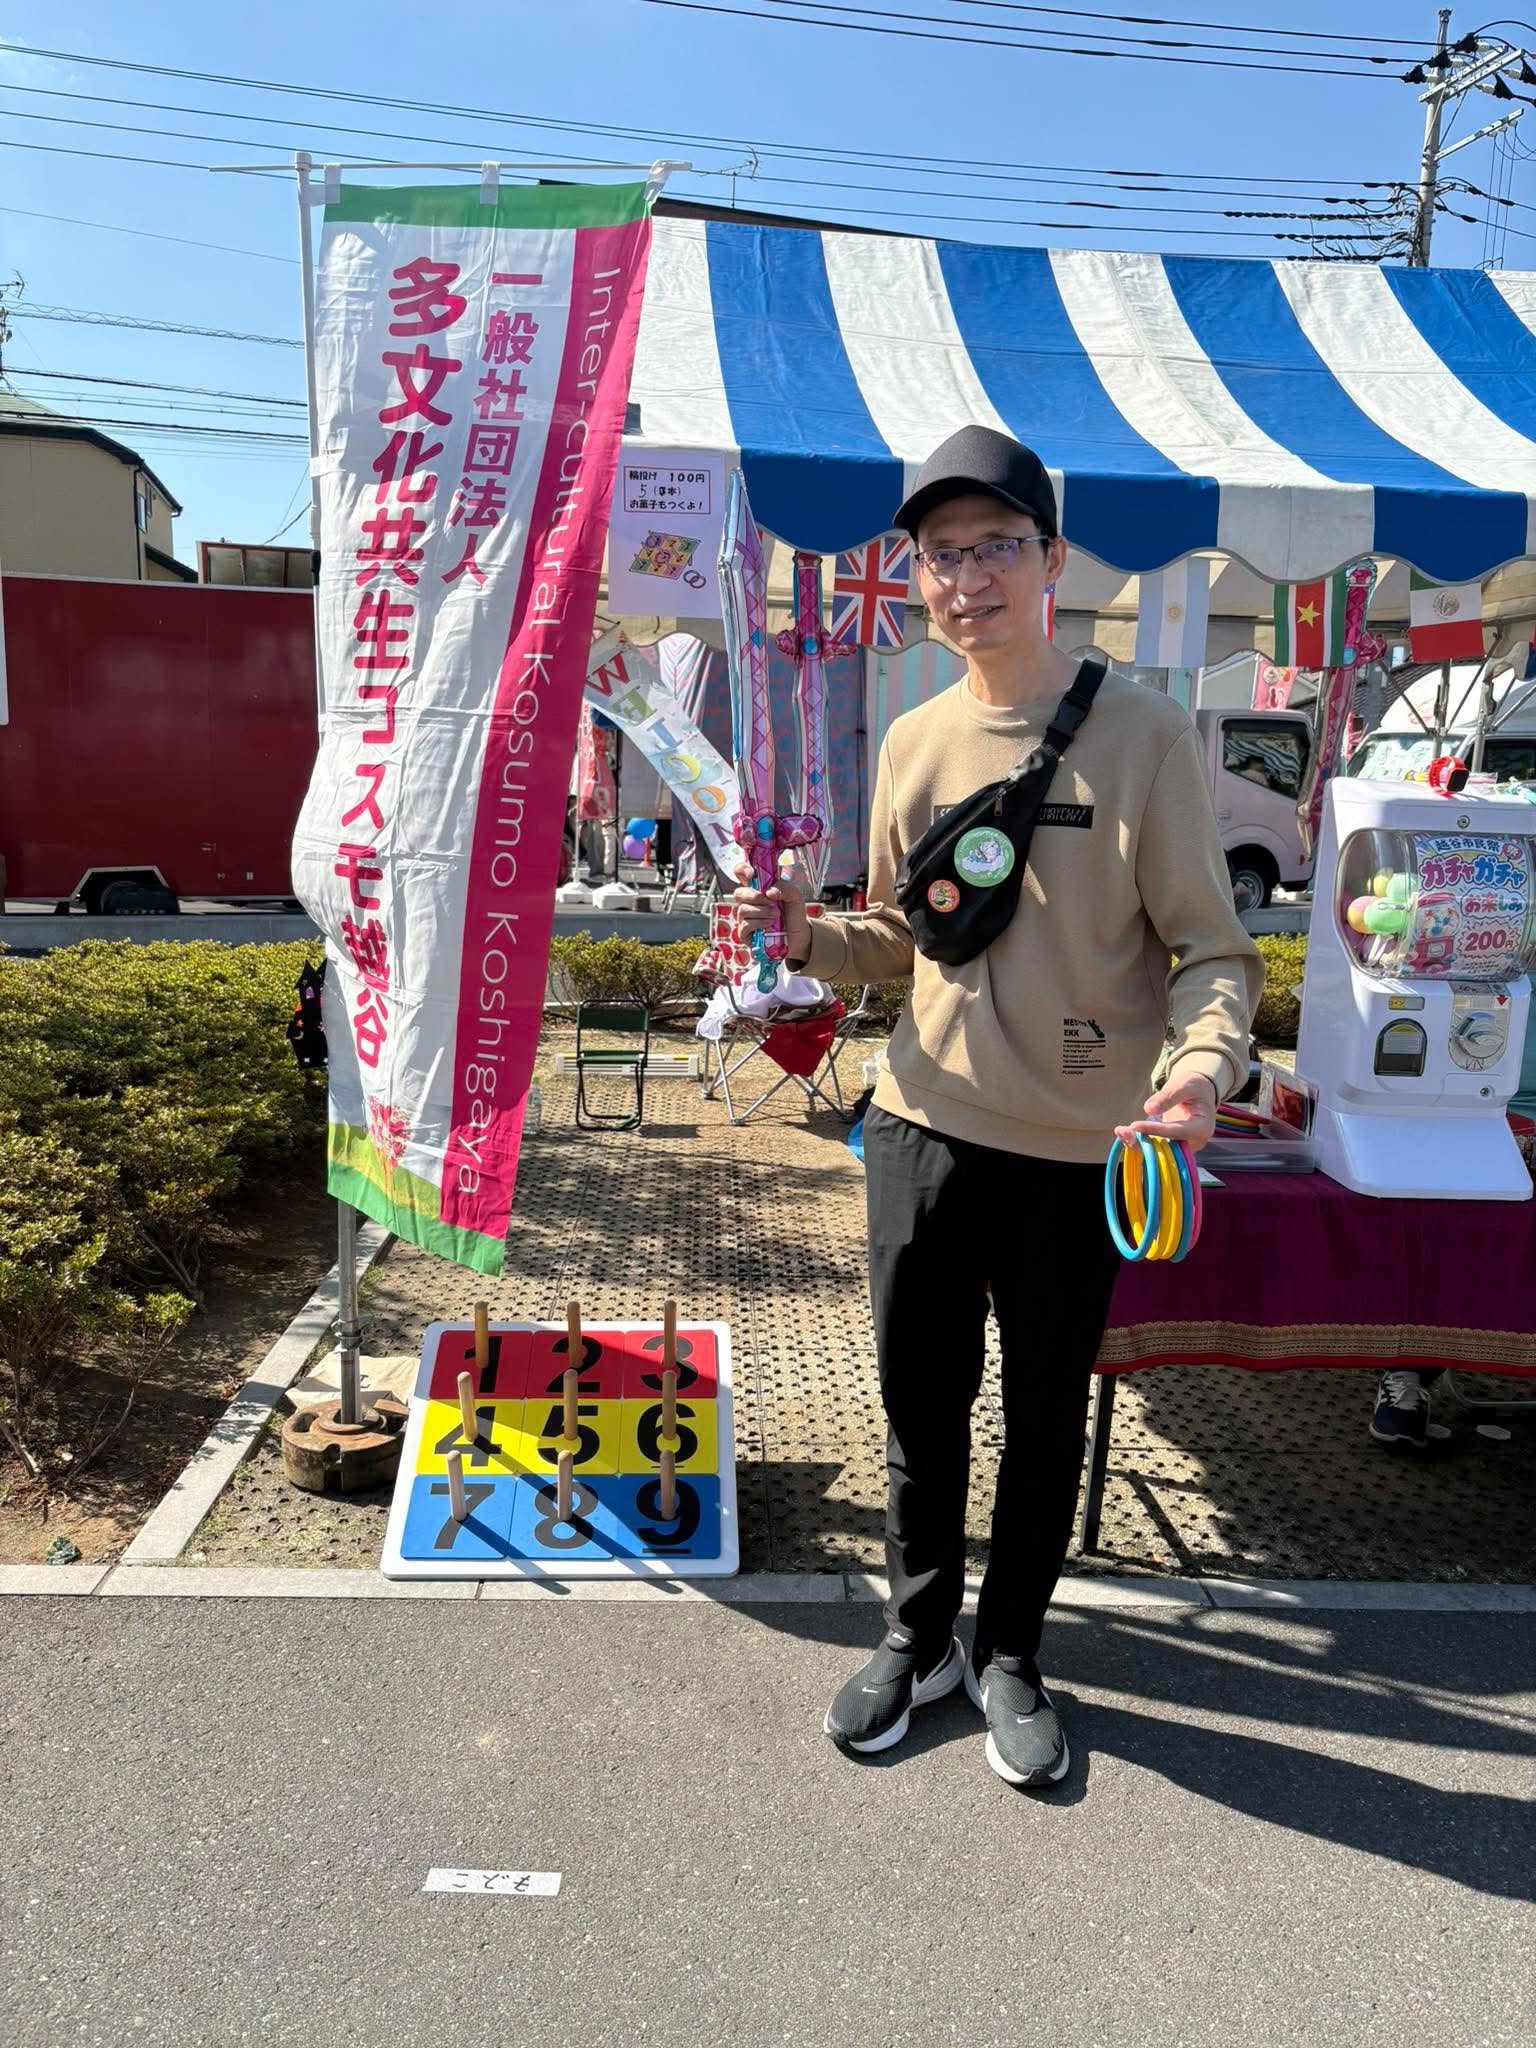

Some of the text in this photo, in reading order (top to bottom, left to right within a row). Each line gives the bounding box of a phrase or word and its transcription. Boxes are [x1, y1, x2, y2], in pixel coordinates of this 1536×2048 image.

[440, 271, 544, 586] 一般社団法人
[334, 256, 469, 1069] 多文化共生コスモ越谷
[456, 268, 621, 1195] Inter-cultural Kosumo Koshigaya
[1420, 854, 1527, 890] ガチャガチャ
[1435, 837, 1500, 853] 越谷市民祭
[1464, 891, 1523, 914] お楽しみ
[1464, 928, 1514, 952] 200円
[464, 1335, 699, 1394] 1 2 3
[434, 1402, 698, 1468] 4 5 6
[429, 1478, 701, 1550] 7 8 9
[452, 1872, 532, 1893] こども
